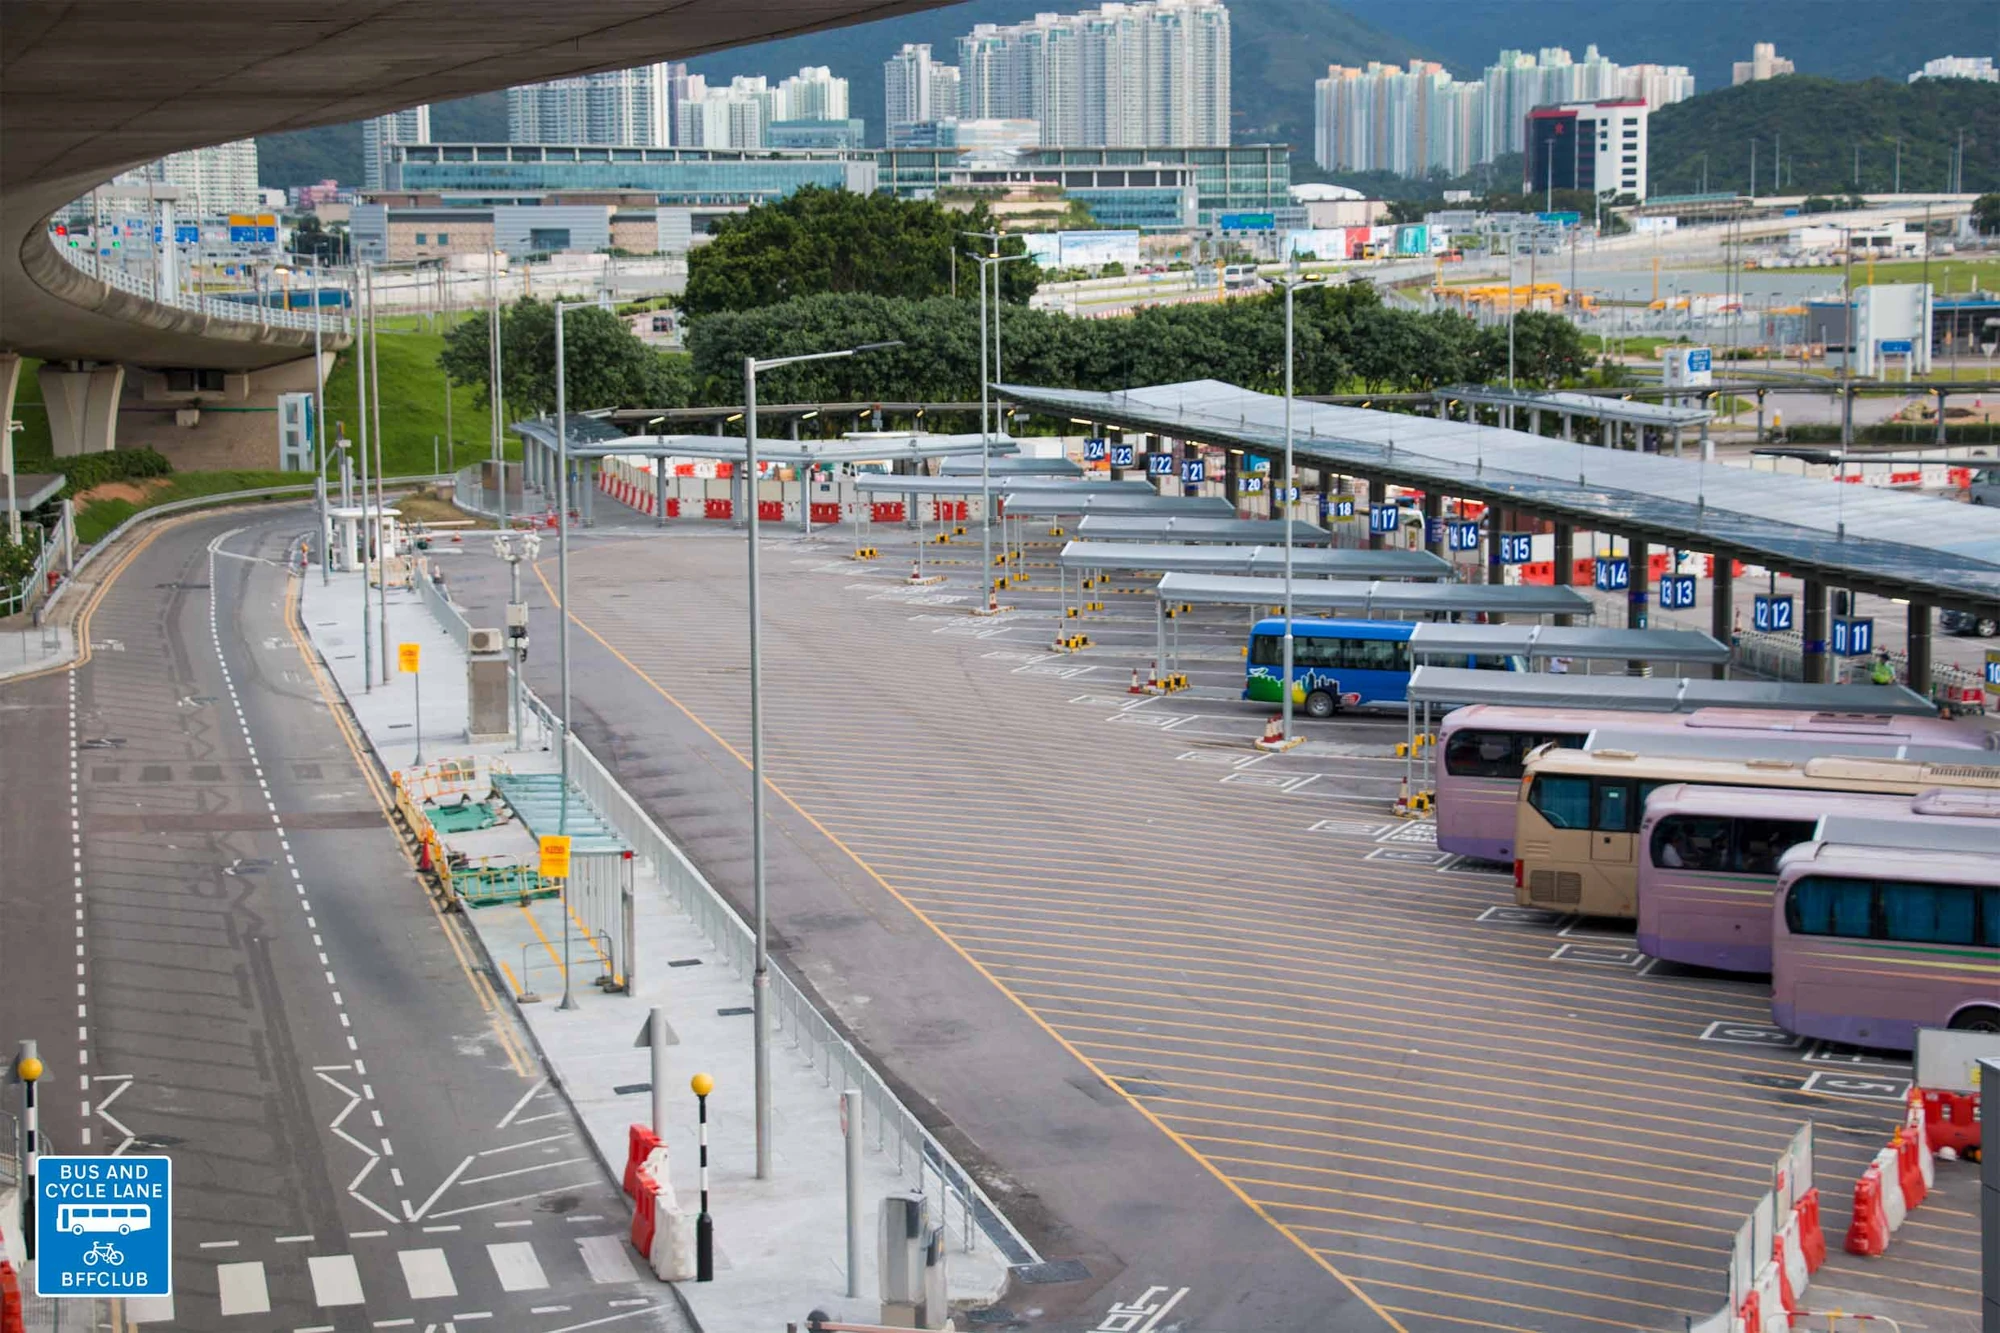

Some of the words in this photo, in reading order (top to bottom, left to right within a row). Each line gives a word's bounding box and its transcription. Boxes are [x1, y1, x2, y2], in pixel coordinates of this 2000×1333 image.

[1089, 441, 1104, 458] 24
[1117, 448, 1132, 464] 23
[1157, 456, 1172, 473] 22
[1190, 463, 1203, 480] 21
[1248, 478, 1261, 491] 20
[1338, 502, 1351, 515] 18
[1382, 508, 1397, 529] 17
[1461, 525, 1476, 547] 16
[1501, 537, 1510, 560] 15
[1513, 537, 1529, 560] 15
[1597, 561, 1607, 586] 14
[1609, 562, 1627, 587] 14
[1662, 580, 1672, 605] 13
[1676, 580, 1693, 605] 13
[1756, 601, 1768, 627] 12
[1772, 601, 1790, 627] 12
[1835, 623, 1846, 651] 11
[1853, 624, 1868, 652] 11
[1825, 1080, 1896, 1093] 5
